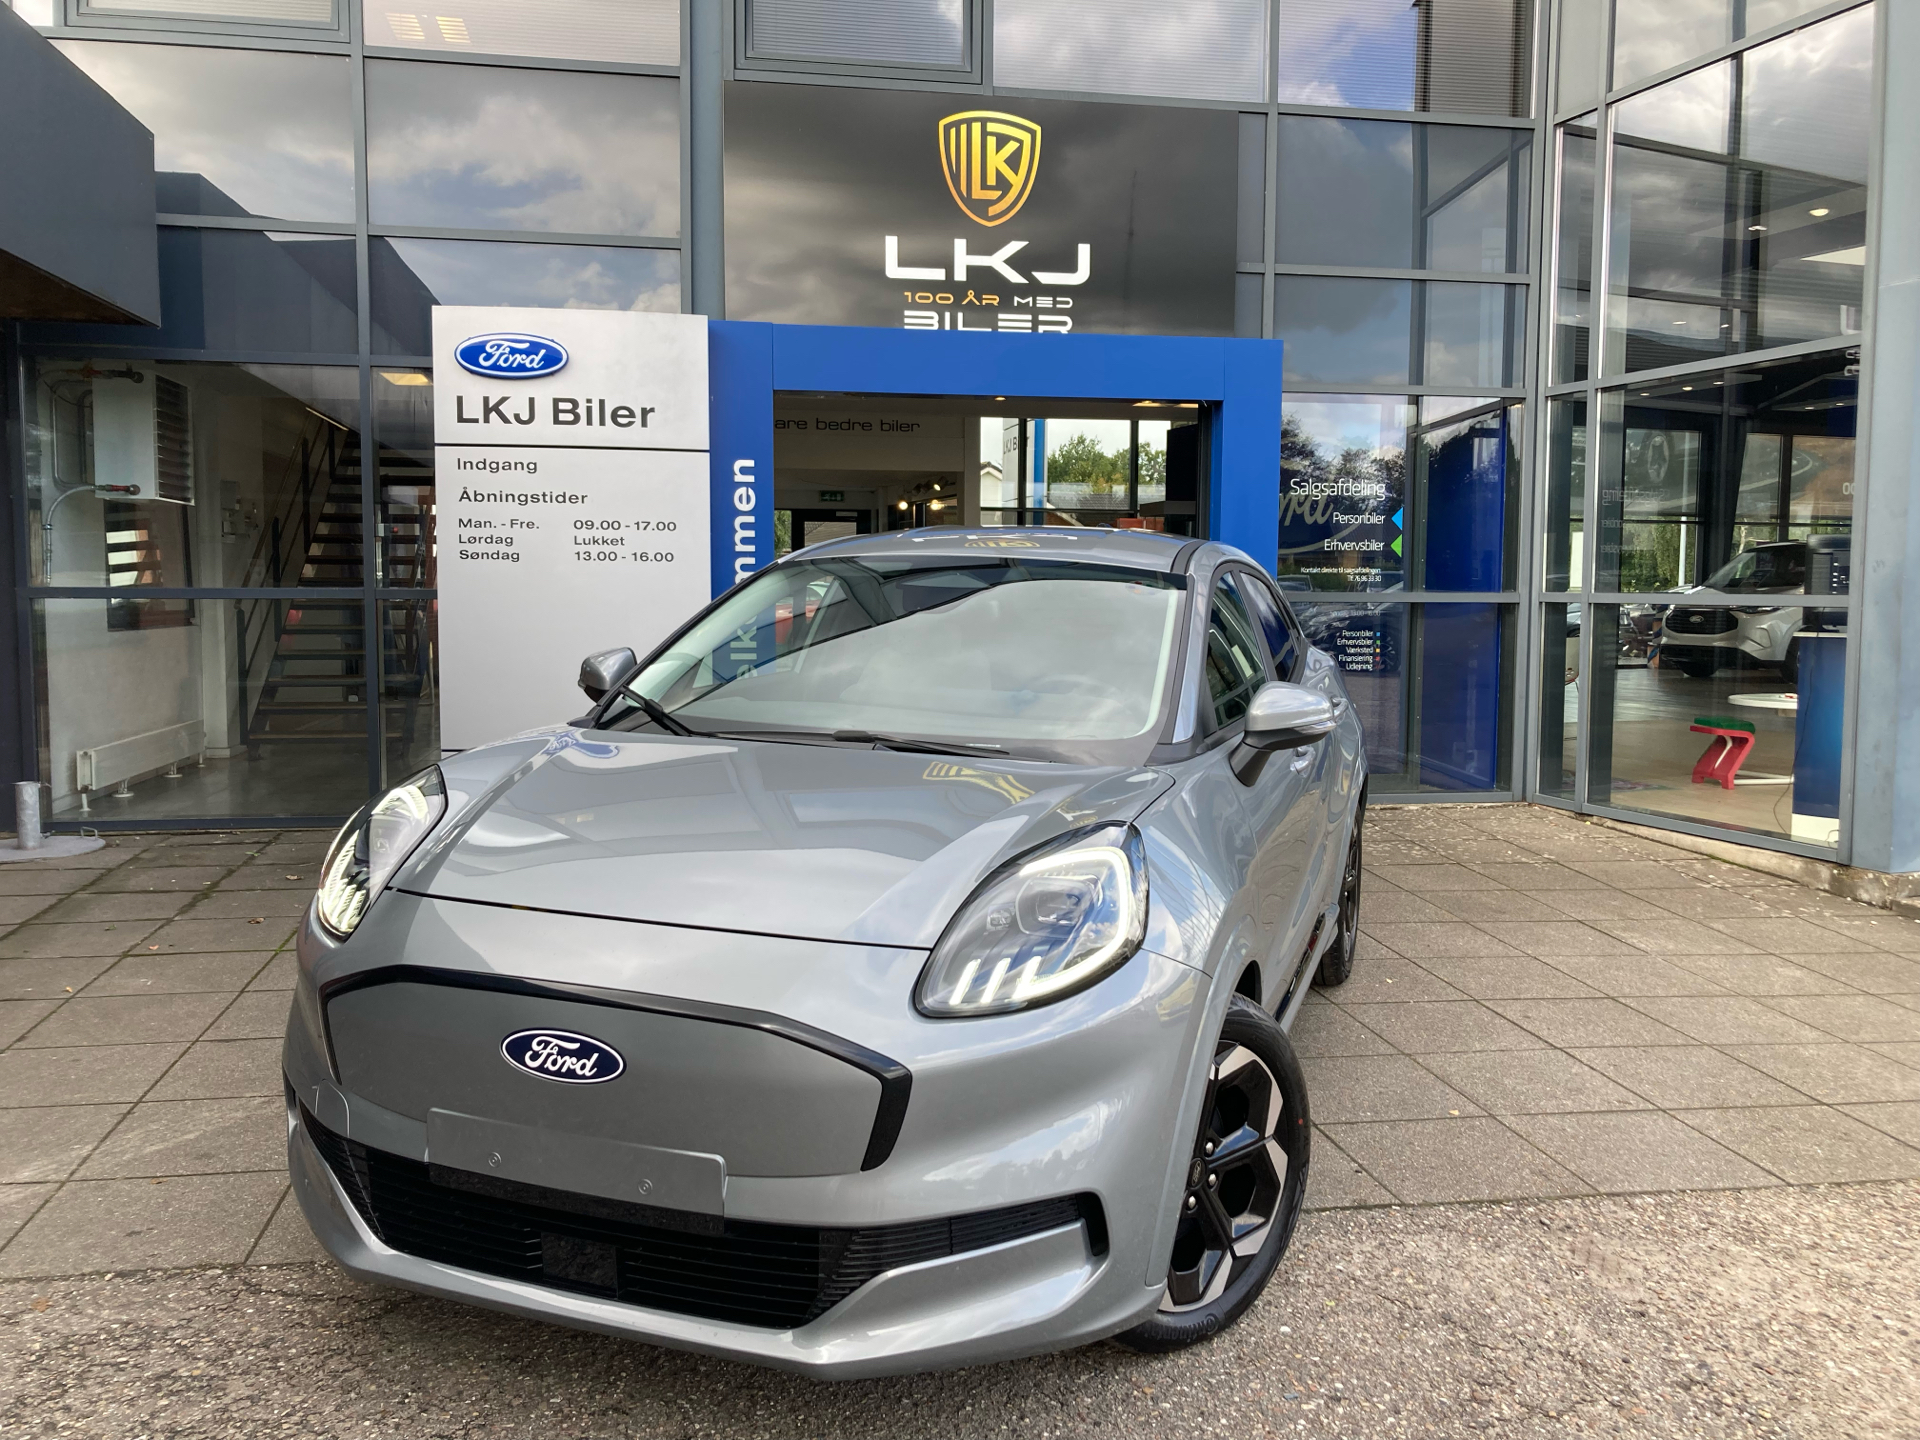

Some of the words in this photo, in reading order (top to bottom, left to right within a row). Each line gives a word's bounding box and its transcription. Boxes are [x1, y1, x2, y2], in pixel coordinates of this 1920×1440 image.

[885, 235, 1091, 285] LKJ
[904, 291, 954, 304] 100
[961, 289, 1000, 306] ÅR
[1013, 295, 1074, 309] MED
[903, 310, 1073, 334] BILER
[478, 340, 547, 369] Ford
[456, 395, 536, 426] LKJ
[552, 397, 655, 429] Biler
[774, 419, 808, 430] are
[815, 418, 873, 431] bedre
[880, 419, 920, 432] biler
[457, 457, 538, 474] Indgang
[458, 487, 589, 505] Åbningstider
[1290, 478, 1386, 500] Salgsafdeling
[458, 518, 497, 529] Man.
[510, 519, 540, 530] Fre.
[1332, 511, 1386, 524] Personbiler
[573, 519, 622, 531] 09.00
[634, 521, 677, 533] 17.00
[458, 533, 514, 548] Lørdag
[573, 536, 626, 547] Lukket
[1324, 538, 1385, 551] Erhvervsbiler
[459, 549, 521, 564] Søndag
[574, 551, 618, 563] 13.00
[631, 552, 675, 564] 16.00
[1337, 638, 1374, 646] Erhvervsbiler
[1339, 655, 1373, 663] Finansiering
[1346, 663, 1373, 671] Udlejning
[524, 1036, 599, 1077] Ford
